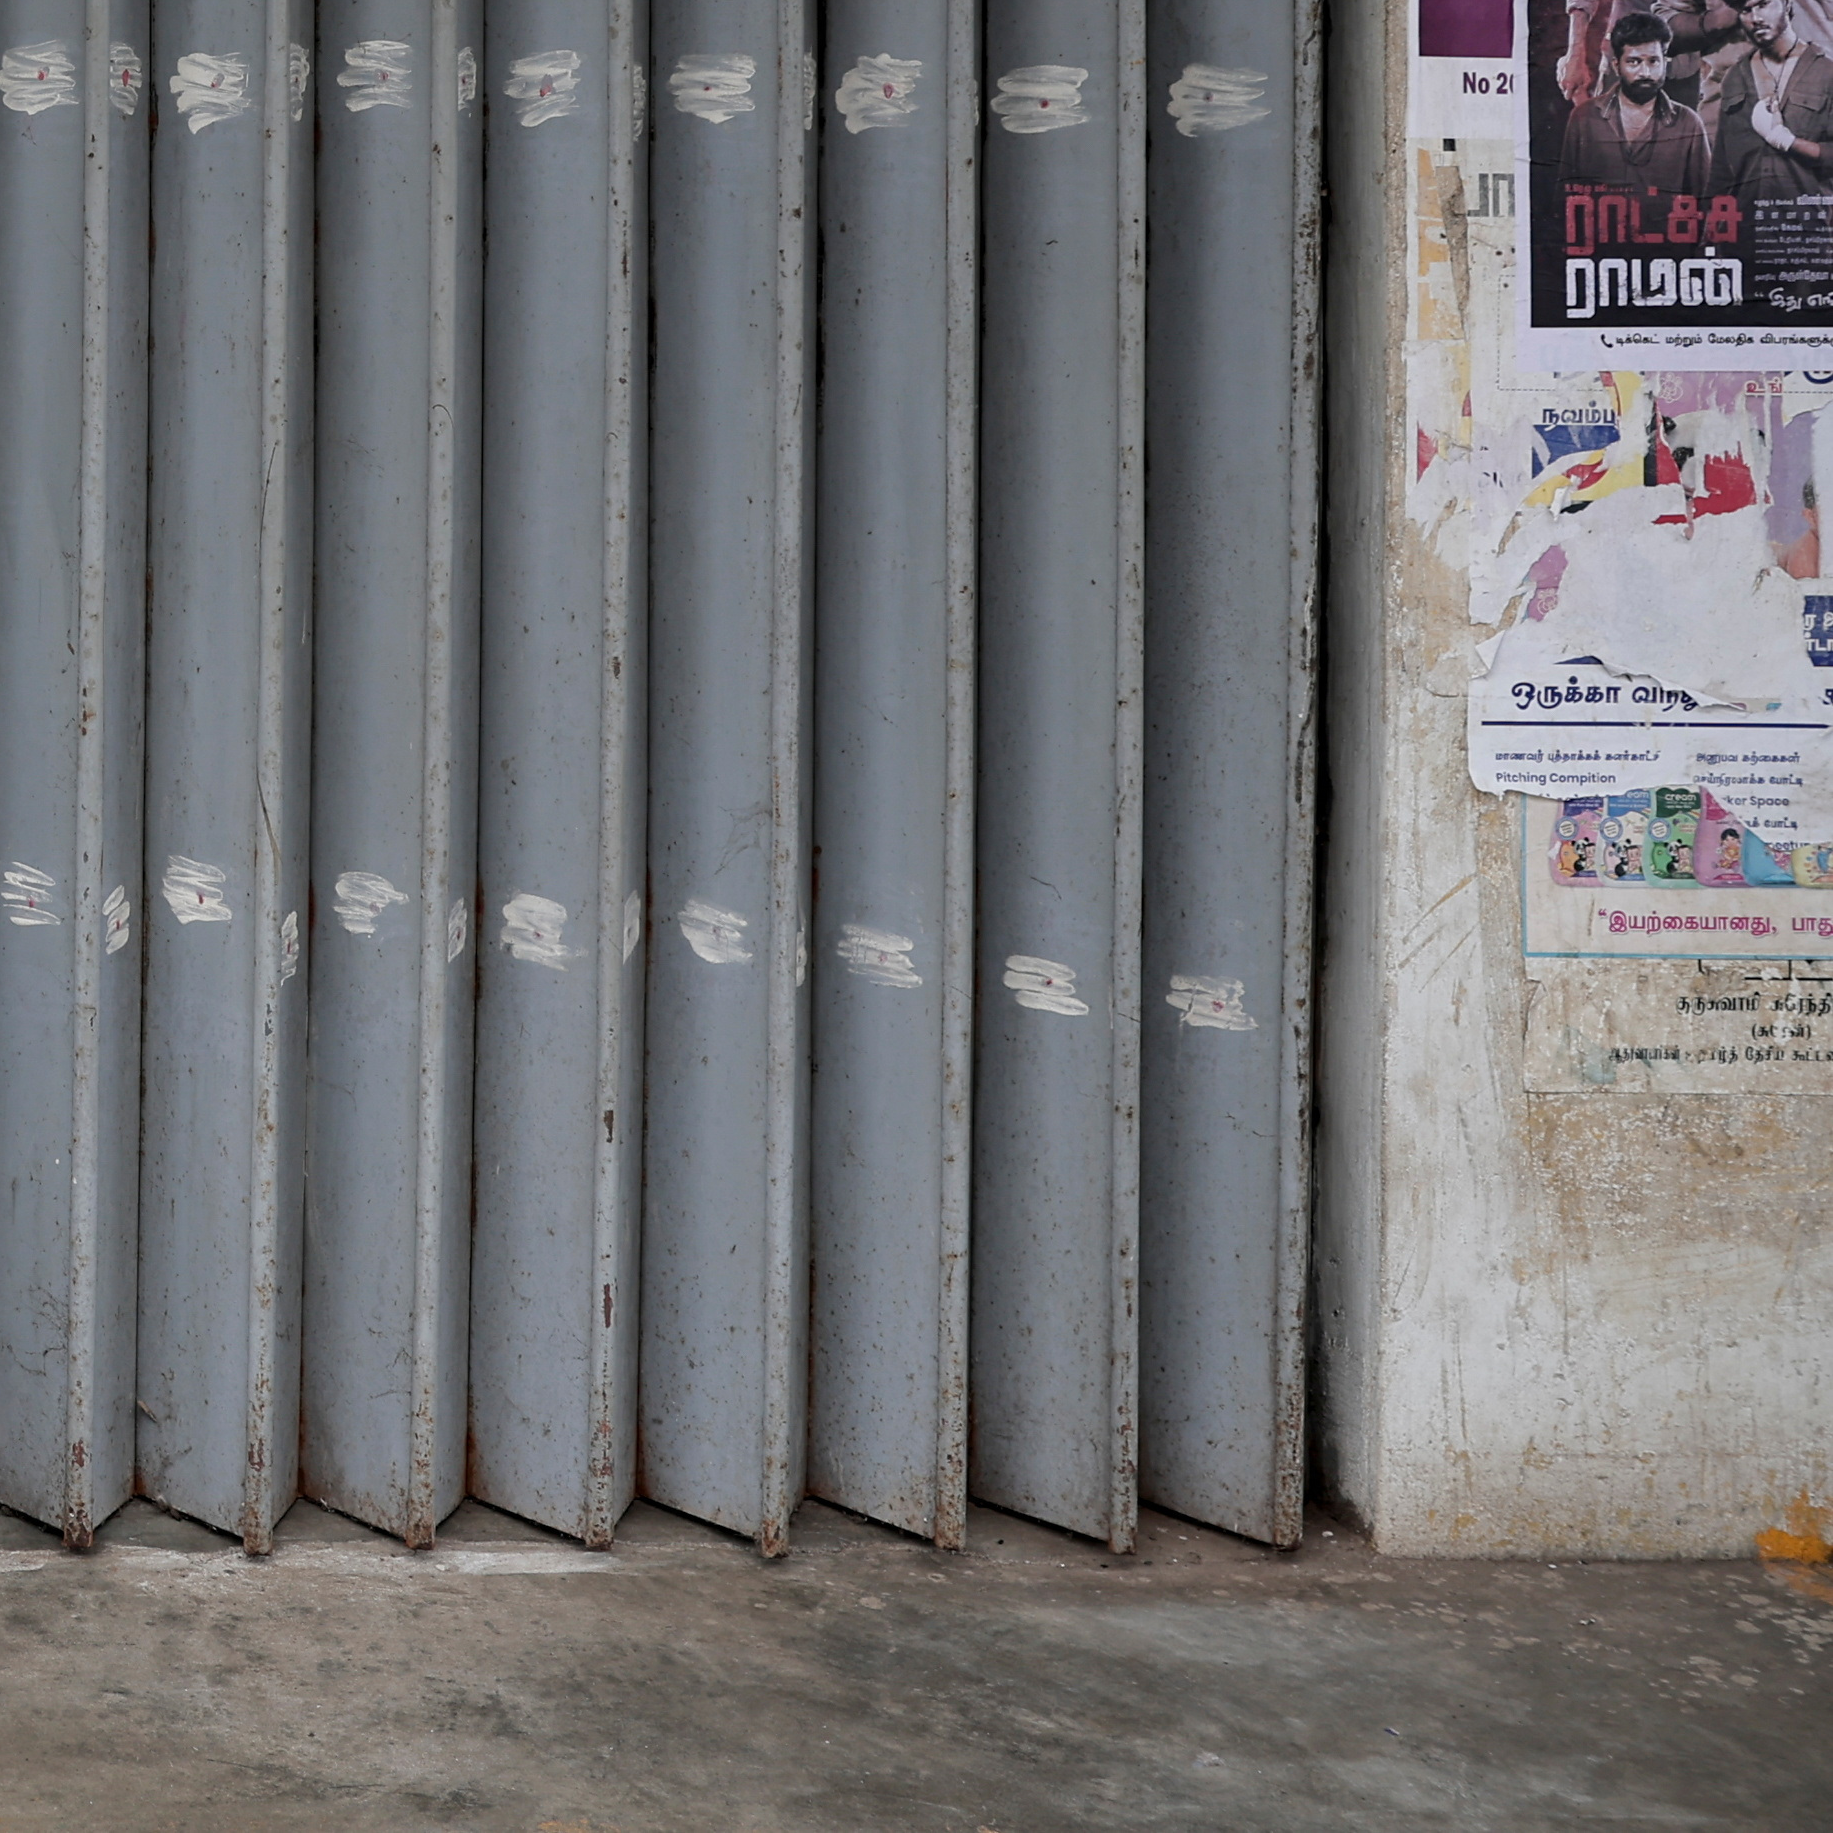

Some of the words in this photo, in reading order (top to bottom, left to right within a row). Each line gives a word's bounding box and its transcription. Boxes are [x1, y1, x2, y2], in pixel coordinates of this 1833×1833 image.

[1462, 71, 1491, 95] No
[1565, 246, 1743, 319] ராமன்
[1665, 332, 1703, 348] மற்றும்
[1510, 674, 1623, 712] ஒருக்கா
[1495, 748, 1545, 764] மாணவர்
[1495, 771, 1547, 786] Pitching
[1548, 772, 1617, 787] Compition
[1663, 790, 1697, 803] cream
[1749, 795, 1790, 810] Space
